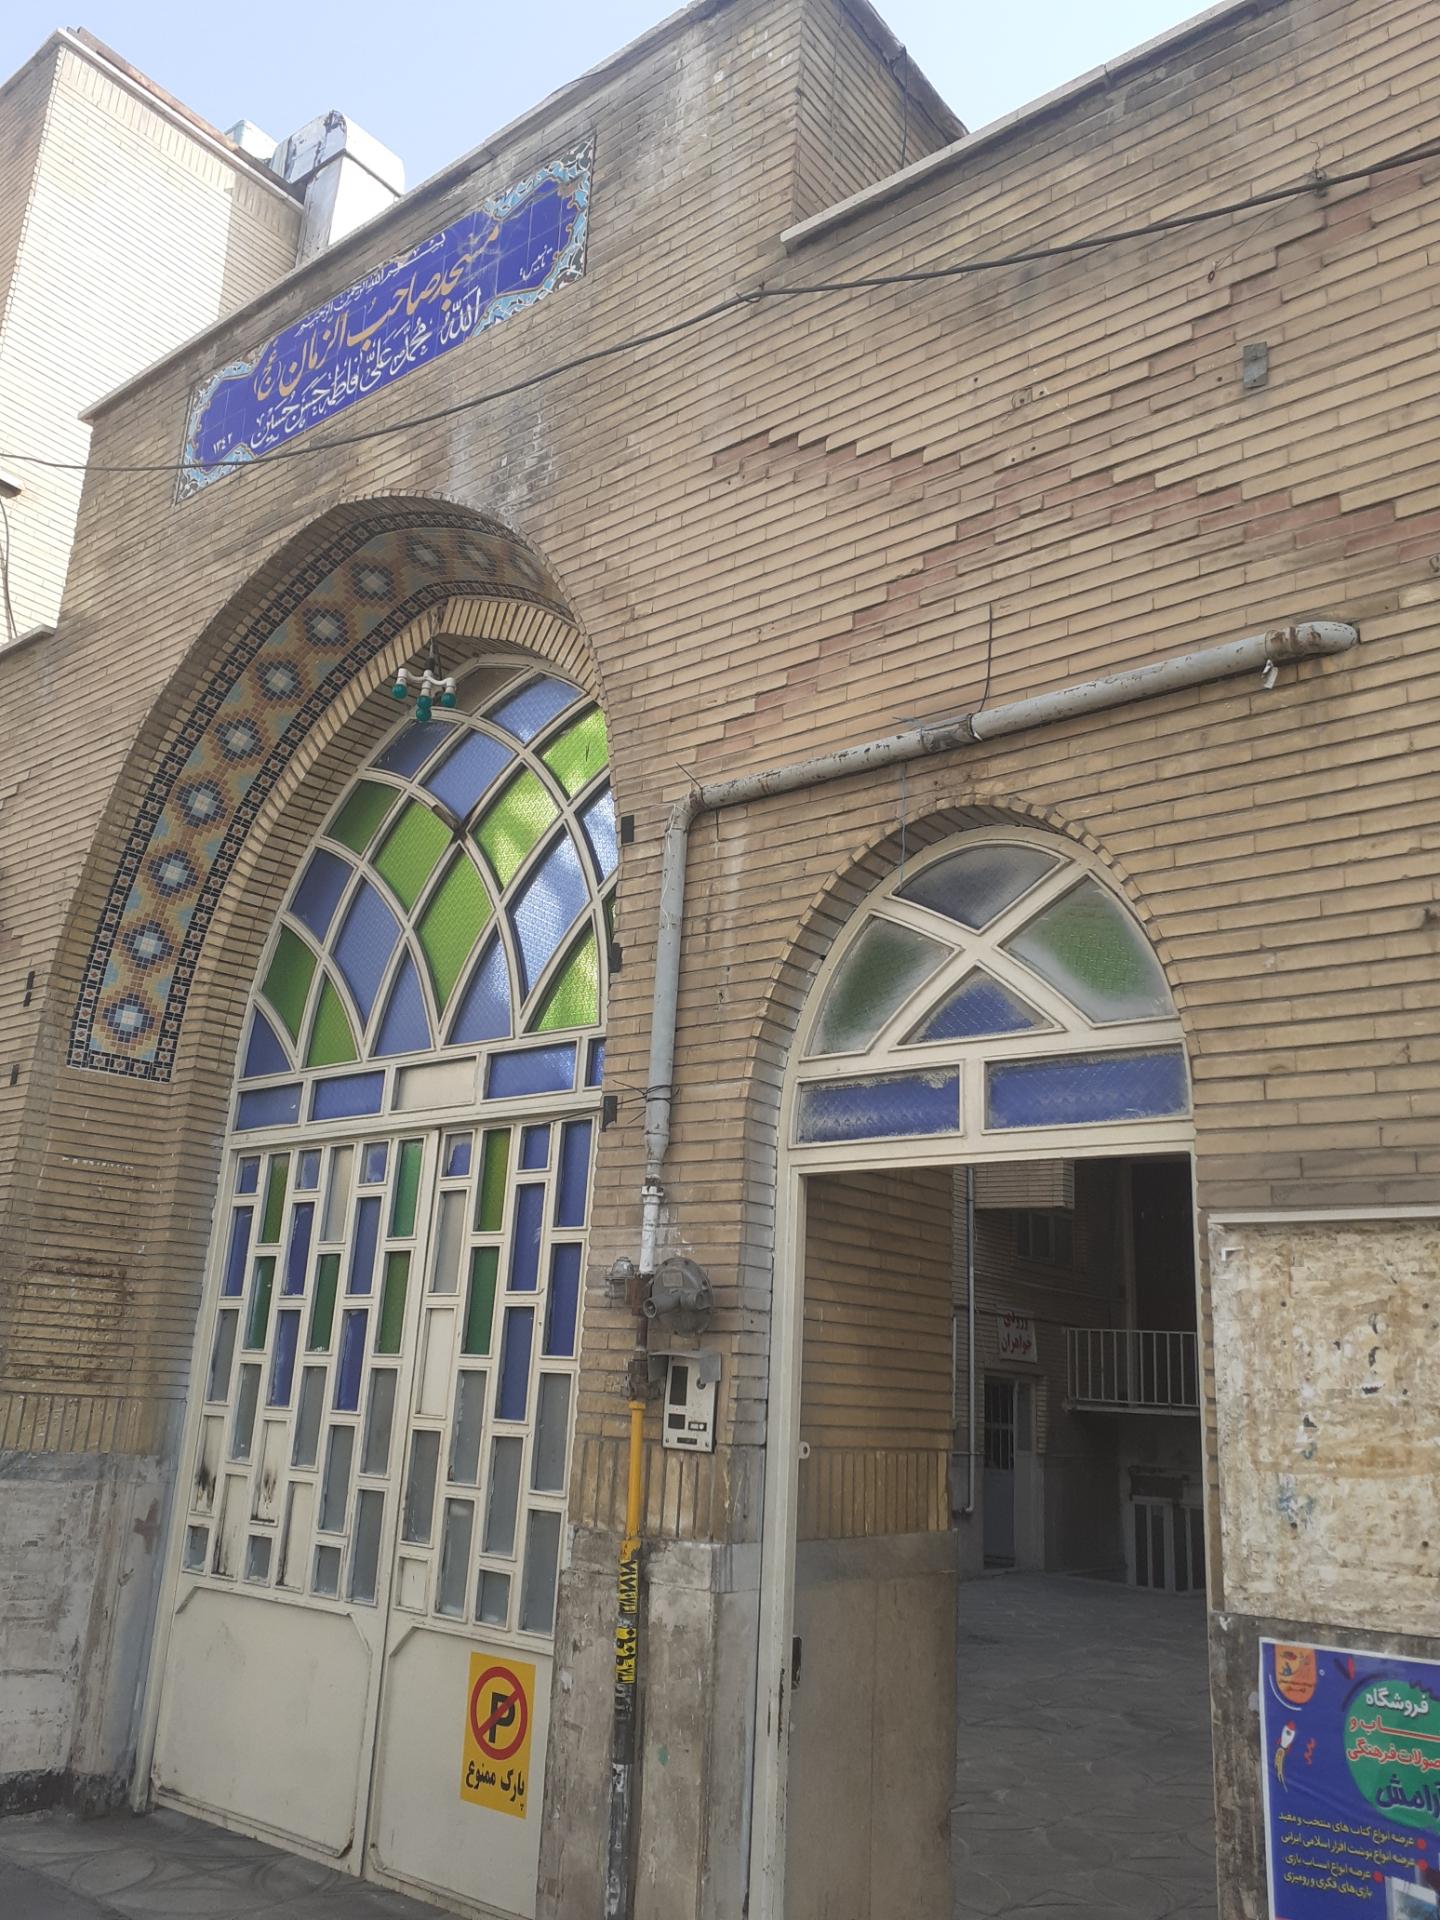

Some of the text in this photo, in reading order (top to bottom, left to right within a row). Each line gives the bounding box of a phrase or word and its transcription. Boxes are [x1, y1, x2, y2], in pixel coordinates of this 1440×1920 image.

[428, 224, 500, 312] مسجد
[347, 271, 442, 352] صاحب
[278, 310, 348, 398] الزمان
[1000, 1332, 1033, 1355] خواهران
[1365, 1687, 1430, 1718] فروشگاه
[1347, 1737, 1399, 1764] فرهنگی
[465, 1759, 525, 1812] پارک ممنوع
[1278, 1811, 1297, 1822] مفید
[1302, 1817, 1331, 1830] منتخب
[1331, 1820, 1350, 1834] های
[1350, 1825, 1372, 1837] کتاب
[1280, 1830, 1302, 1845] ایرانی
[1302, 1834, 1331, 1850] اسلامی
[1372, 1828, 1391, 1845] انواع
[1391, 1833, 1415, 1848] عرضه
[1284, 1852, 1301, 1867] بازی
[1372, 1849, 1392, 1865] انواع
[1391, 1854, 1417, 1868] عرضه
[1330, 1862, 1348, 1878] انواع
[1348, 1866, 1372, 1881] عرضه
[1283, 1871, 1312, 1889] رومیزی
[1315, 1874, 1338, 1890] فکری
